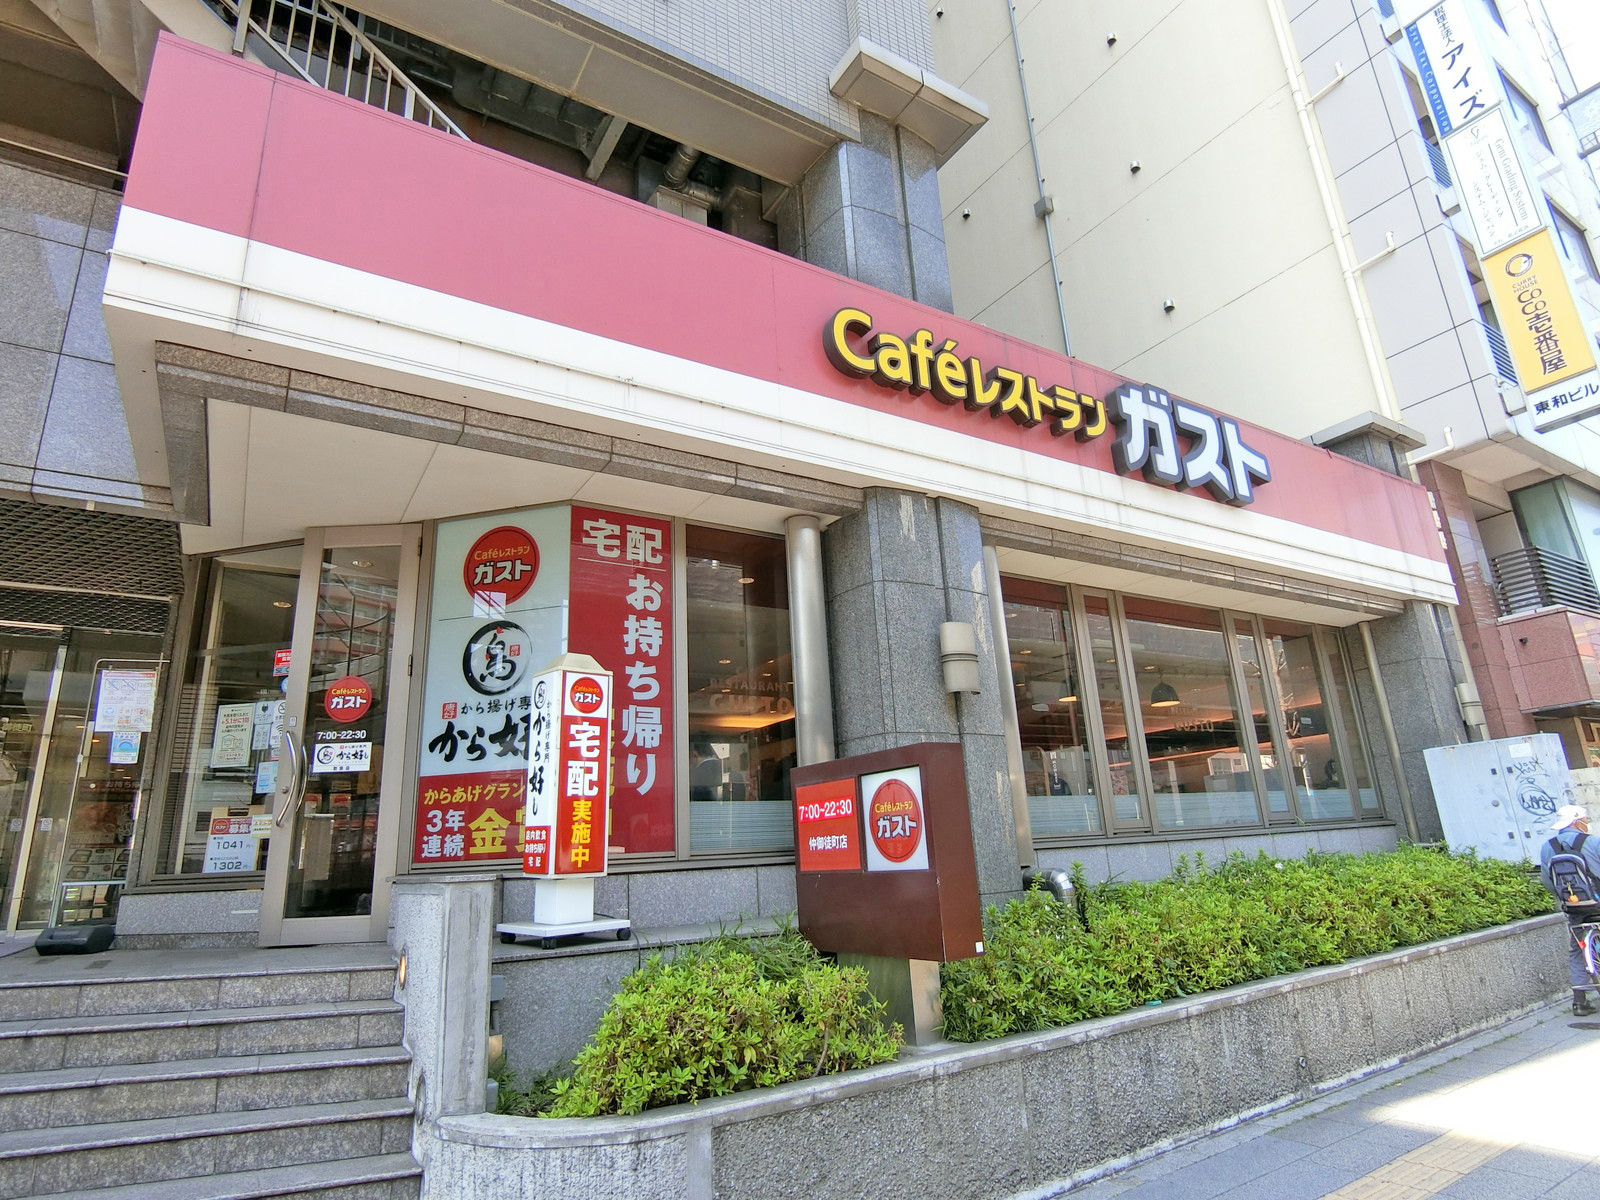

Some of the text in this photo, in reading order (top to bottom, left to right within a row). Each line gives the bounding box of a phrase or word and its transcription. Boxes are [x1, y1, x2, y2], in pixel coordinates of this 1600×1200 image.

[1434, 5, 1456, 47] 税理士法人
[1417, 49, 1428, 69] Tax
[1425, 71, 1451, 132] Corporation
[1441, 43, 1486, 119] アイズ
[1502, 157, 1519, 193] Grading
[1512, 274, 1537, 288] CURRY
[1513, 279, 1539, 294] HOUSE
[1533, 382, 1600, 416] 東和ビル
[1110, 383, 1272, 507] ガスト
[474, 546, 530, 560] Caféレストラン
[582, 518, 663, 565] 宅配
[473, 559, 532, 586] ガスト
[622, 573, 664, 796] お持ち帰り
[330, 695, 367, 709] ガスト
[574, 692, 601, 704] ガスト
[529, 712, 546, 816] から好し
[567, 721, 600, 798] 宅配
[424, 783, 526, 805] からあげグラン
[426, 809, 466, 833] 3年
[570, 799, 593, 868] 実施中
[877, 814, 917, 839] ガスト
[216, 841, 244, 850] 1041
[421, 833, 465, 858] 連続
[808, 834, 848, 850] 仲御徒町店
[212, 861, 242, 871] 1302
